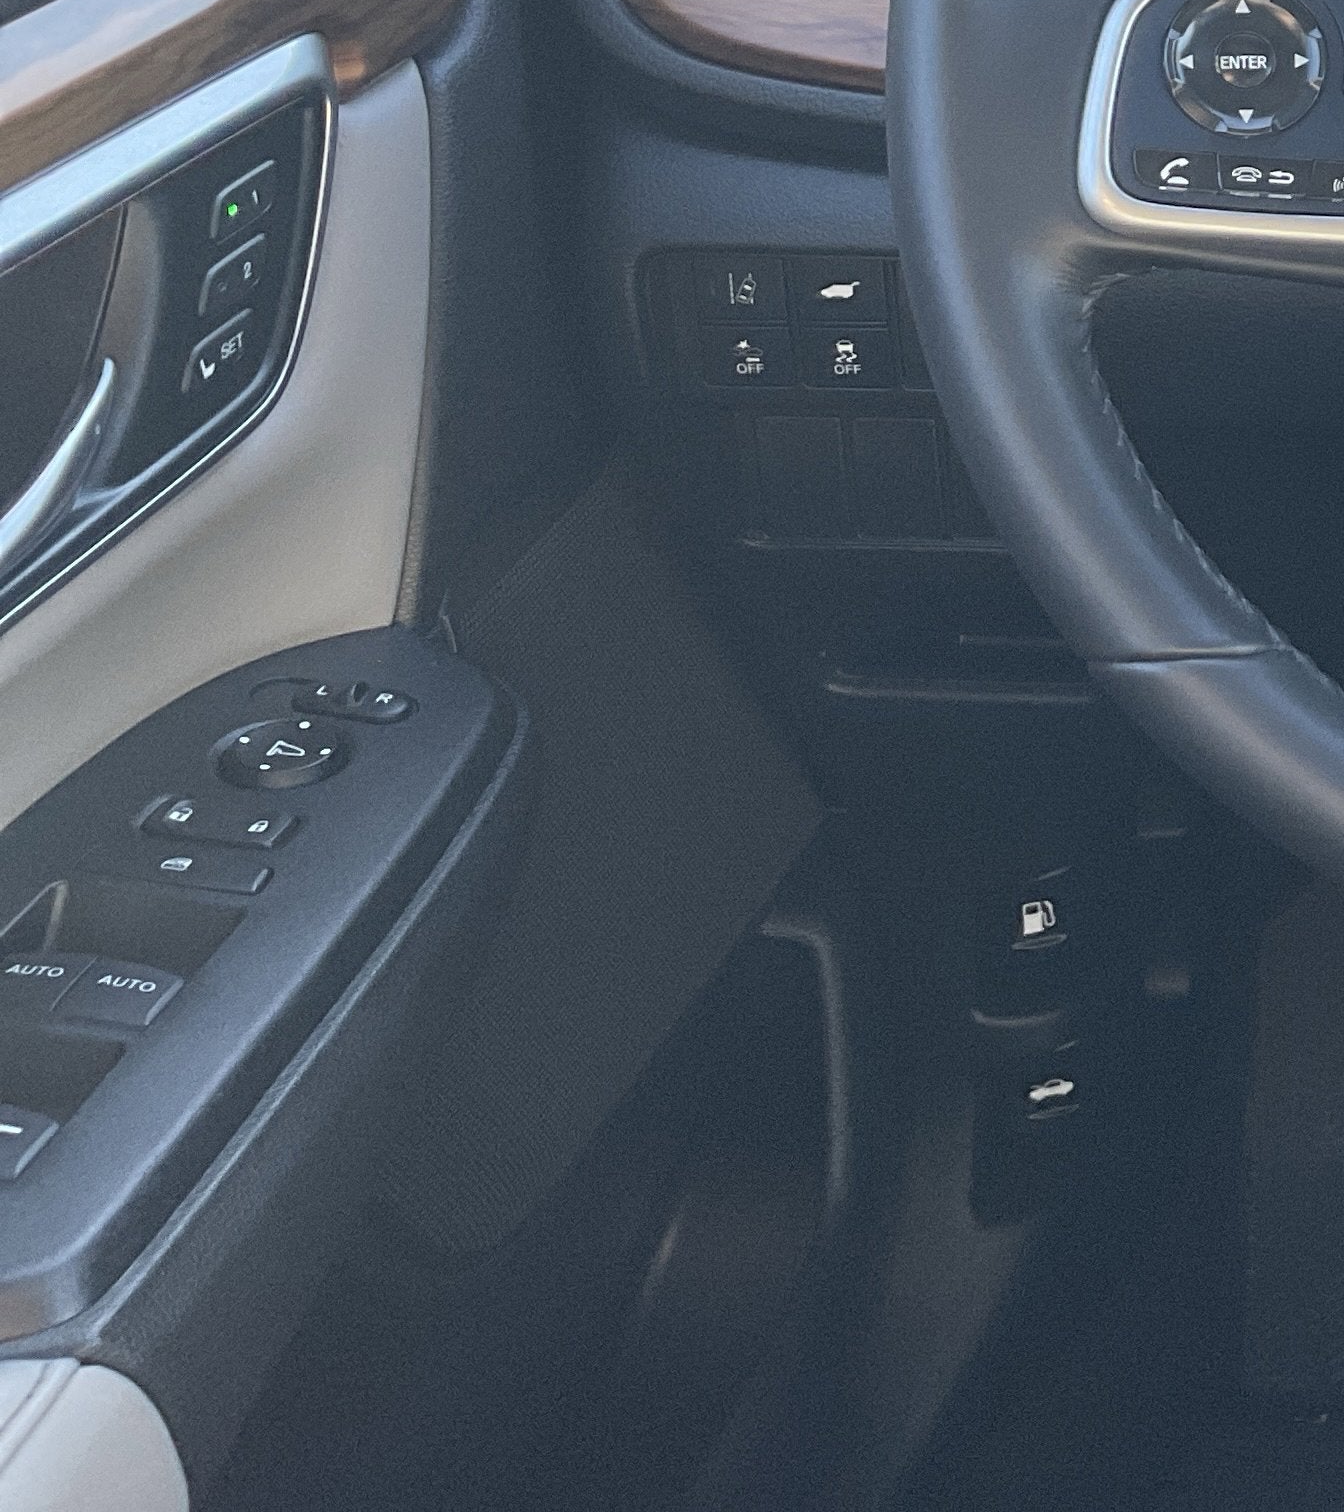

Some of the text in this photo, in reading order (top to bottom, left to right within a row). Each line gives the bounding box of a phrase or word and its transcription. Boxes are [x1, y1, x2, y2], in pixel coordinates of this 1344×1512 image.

[1219, 55, 1267, 70] ENTER
[242, 262, 253, 278] 2
[220, 333, 245, 361] SET
[736, 363, 765, 376] OFF
[833, 363, 861, 376] OFF
[316, 685, 329, 696] L
[375, 693, 393, 704] R
[5, 963, 65, 978] AUTO
[98, 973, 157, 993] AUTO
